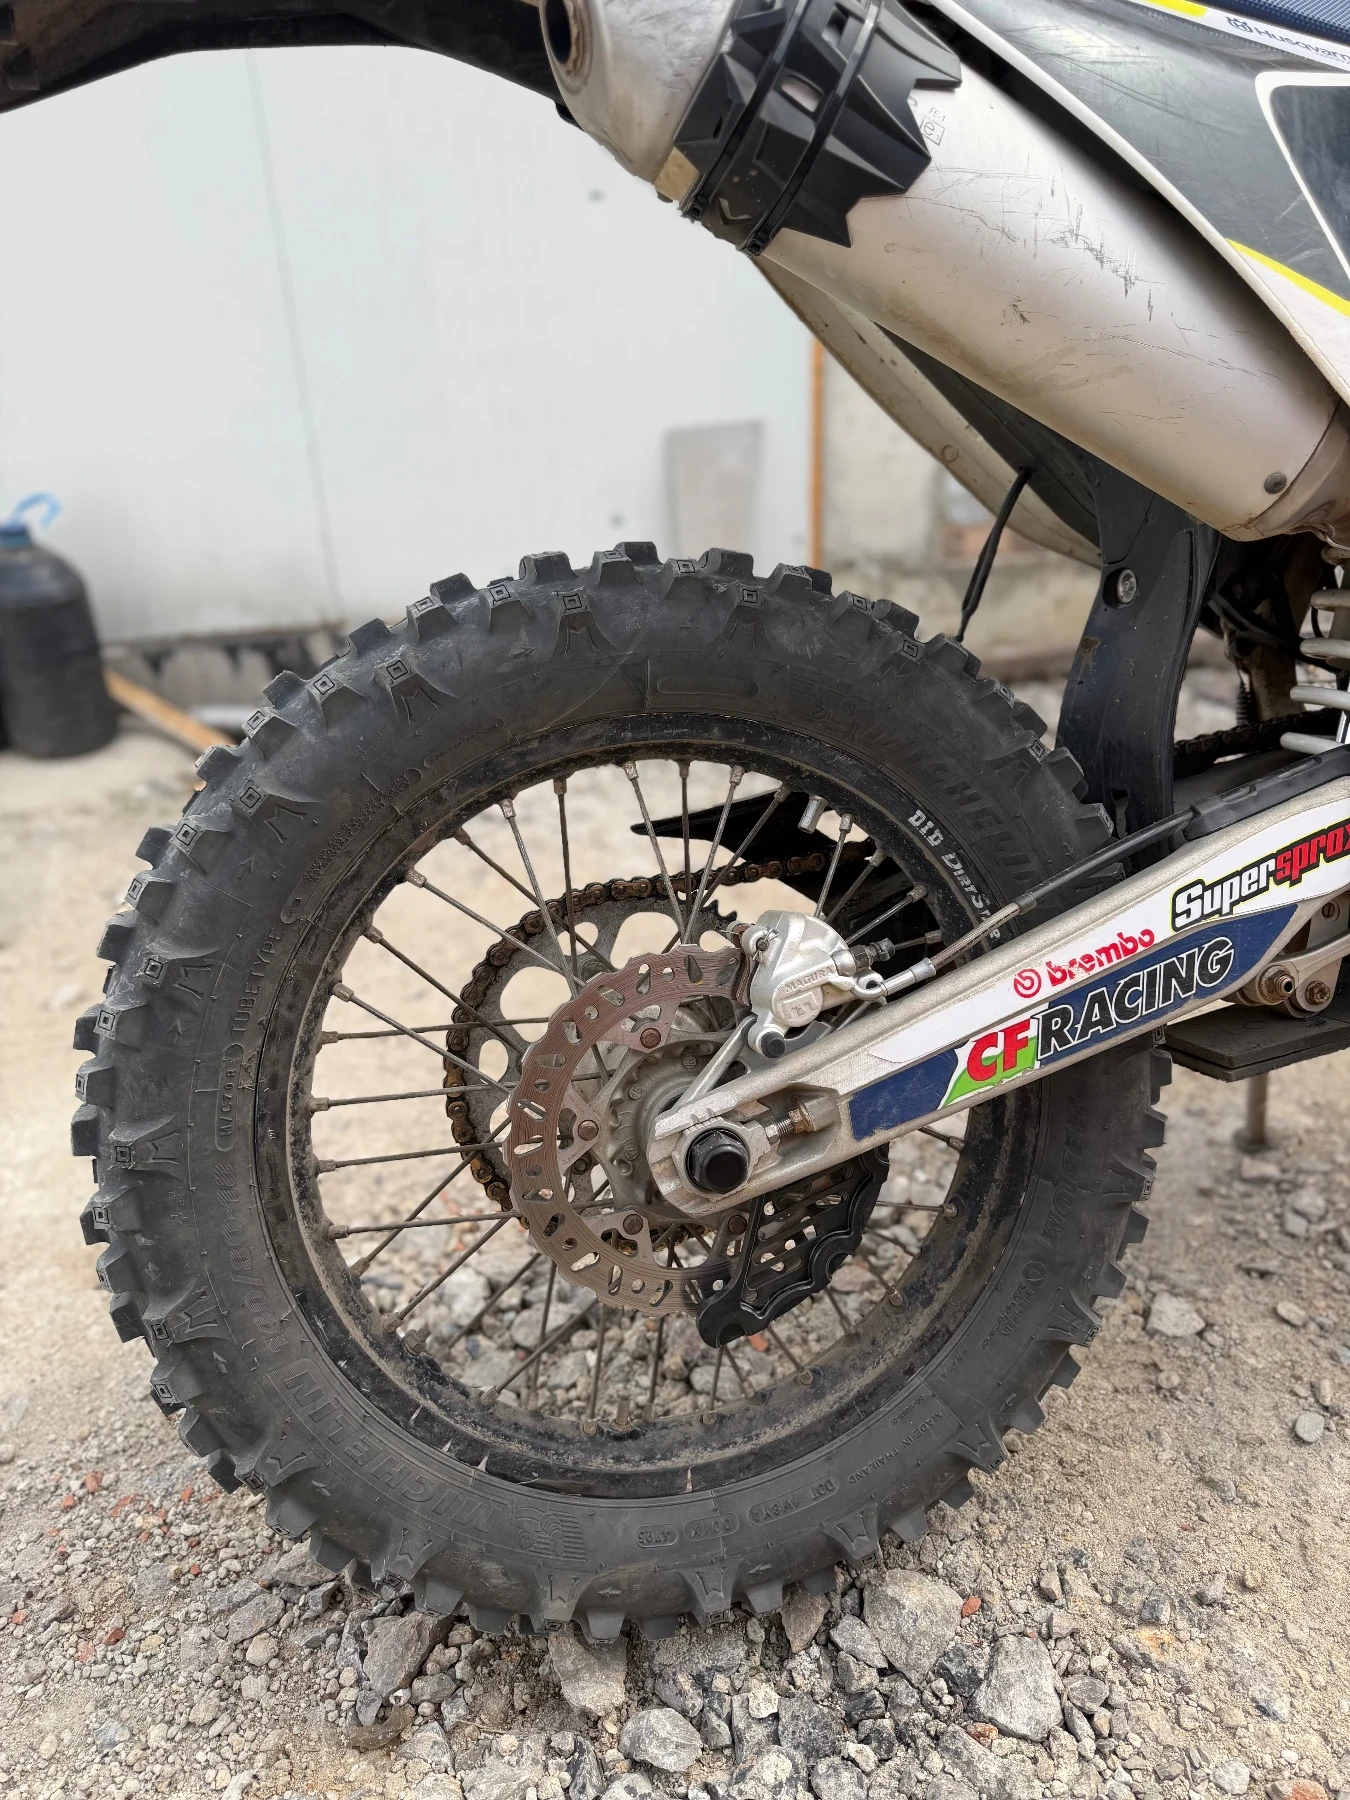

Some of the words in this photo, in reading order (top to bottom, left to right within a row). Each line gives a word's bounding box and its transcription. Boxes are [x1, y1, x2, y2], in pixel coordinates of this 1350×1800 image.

[1045, 927, 1156, 987] brembo
[230, 927, 286, 1037] TUBETYPE
[966, 1017, 1031, 1083] CF
[1032, 936, 1235, 1061] RACING
[901, 1434, 914, 1449] IN
[912, 1410, 943, 1438] MADE
[281, 1369, 502, 1534] MICHELIN
[847, 1446, 900, 1484] THAILAND
[809, 1478, 836, 1501] DOT
